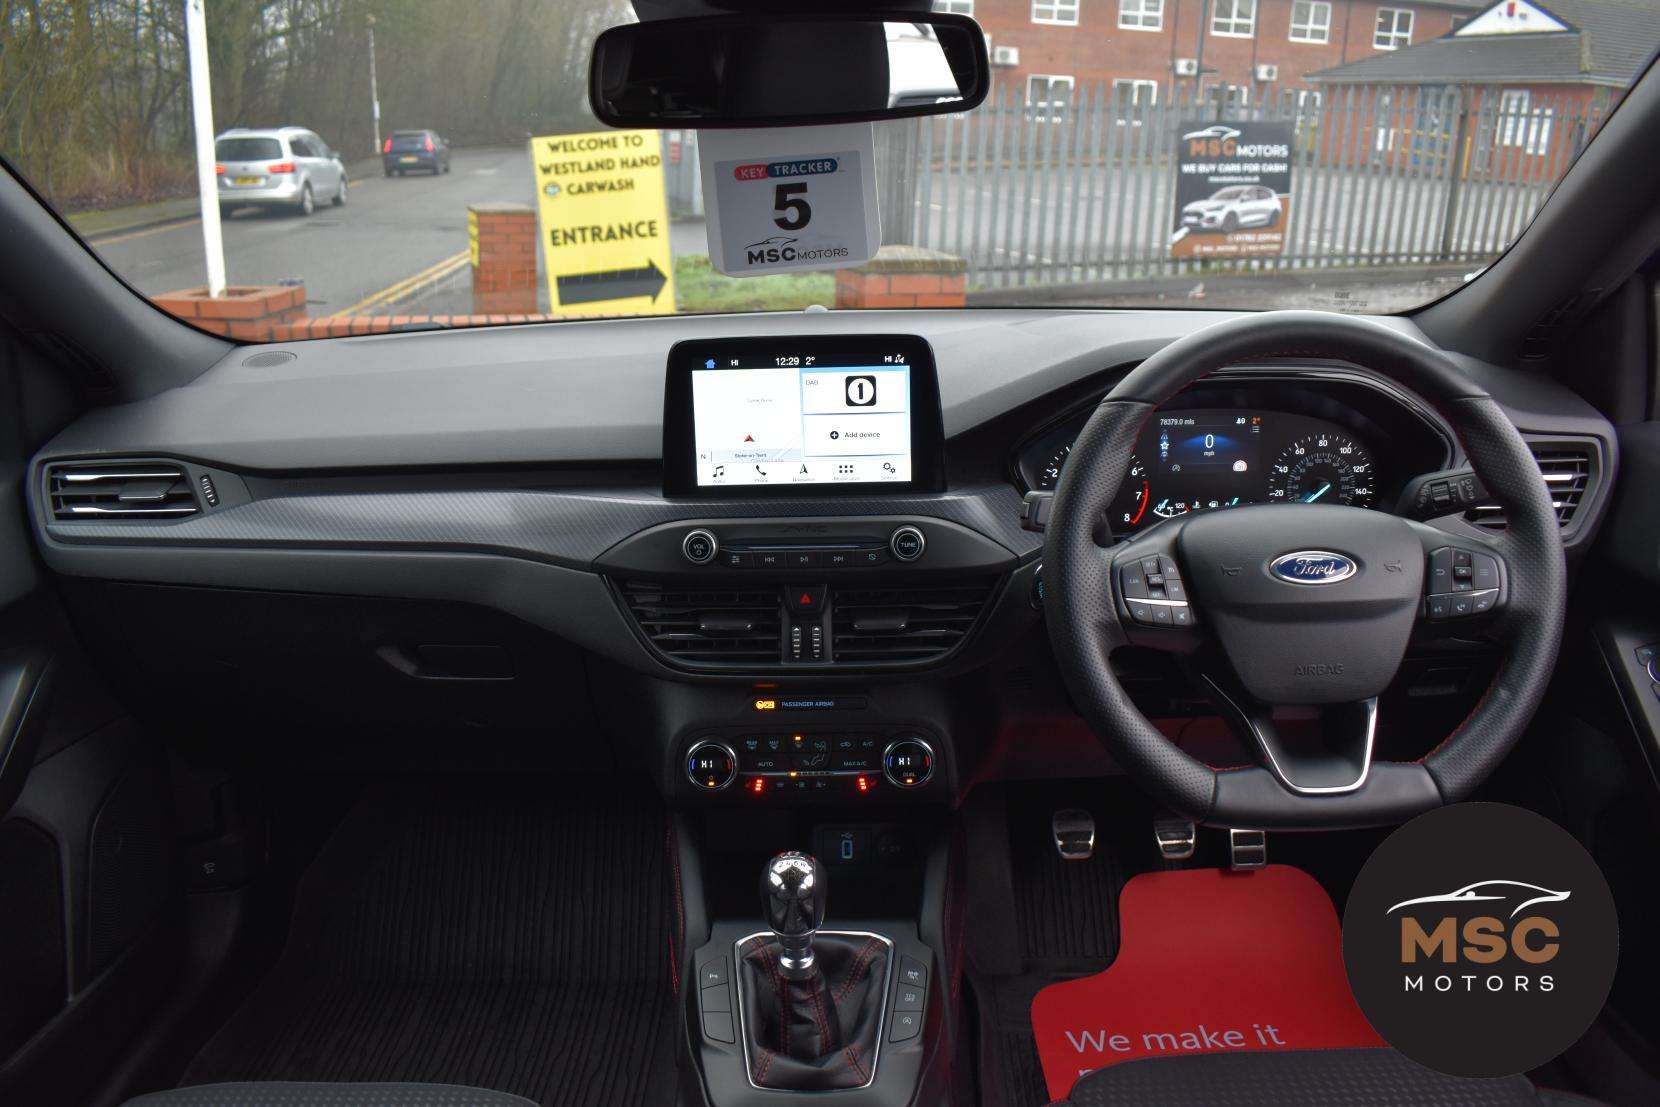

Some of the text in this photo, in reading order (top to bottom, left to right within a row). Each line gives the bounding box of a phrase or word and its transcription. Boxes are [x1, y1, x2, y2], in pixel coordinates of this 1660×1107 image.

[548, 134, 643, 152] WELCOME TO
[1189, 138, 1288, 158] MSC MOTORS
[540, 155, 660, 175] WESTLAND HAND
[740, 161, 832, 179] KEY TRACKER
[1182, 163, 1196, 173] WE
[566, 178, 634, 195] CARWASH
[773, 182, 812, 231] 5
[550, 220, 658, 247] ENTRANCE
[747, 247, 849, 264] MSC MOTORS
[731, 359, 739, 367] HI
[775, 357, 800, 366] 12:29
[884, 355, 893, 363] HI
[1205, 434, 1214, 449] 0
[1318, 439, 1328, 447] 80
[1295, 447, 1305, 455] 60
[1051, 468, 1058, 478] 2
[1131, 467, 1138, 476] 6
[1278, 465, 1288, 473] 40
[1352, 465, 1365, 473] 120
[1135, 491, 1142, 501] 7
[1274, 489, 1284, 497] 20
[1354, 487, 1367, 495] 140
[1123, 513, 1131, 522] 8
[1294, 558, 1336, 575] Ford
[1296, 663, 1345, 676] AIRBAG
[1065, 1023, 1287, 1053] We make it
